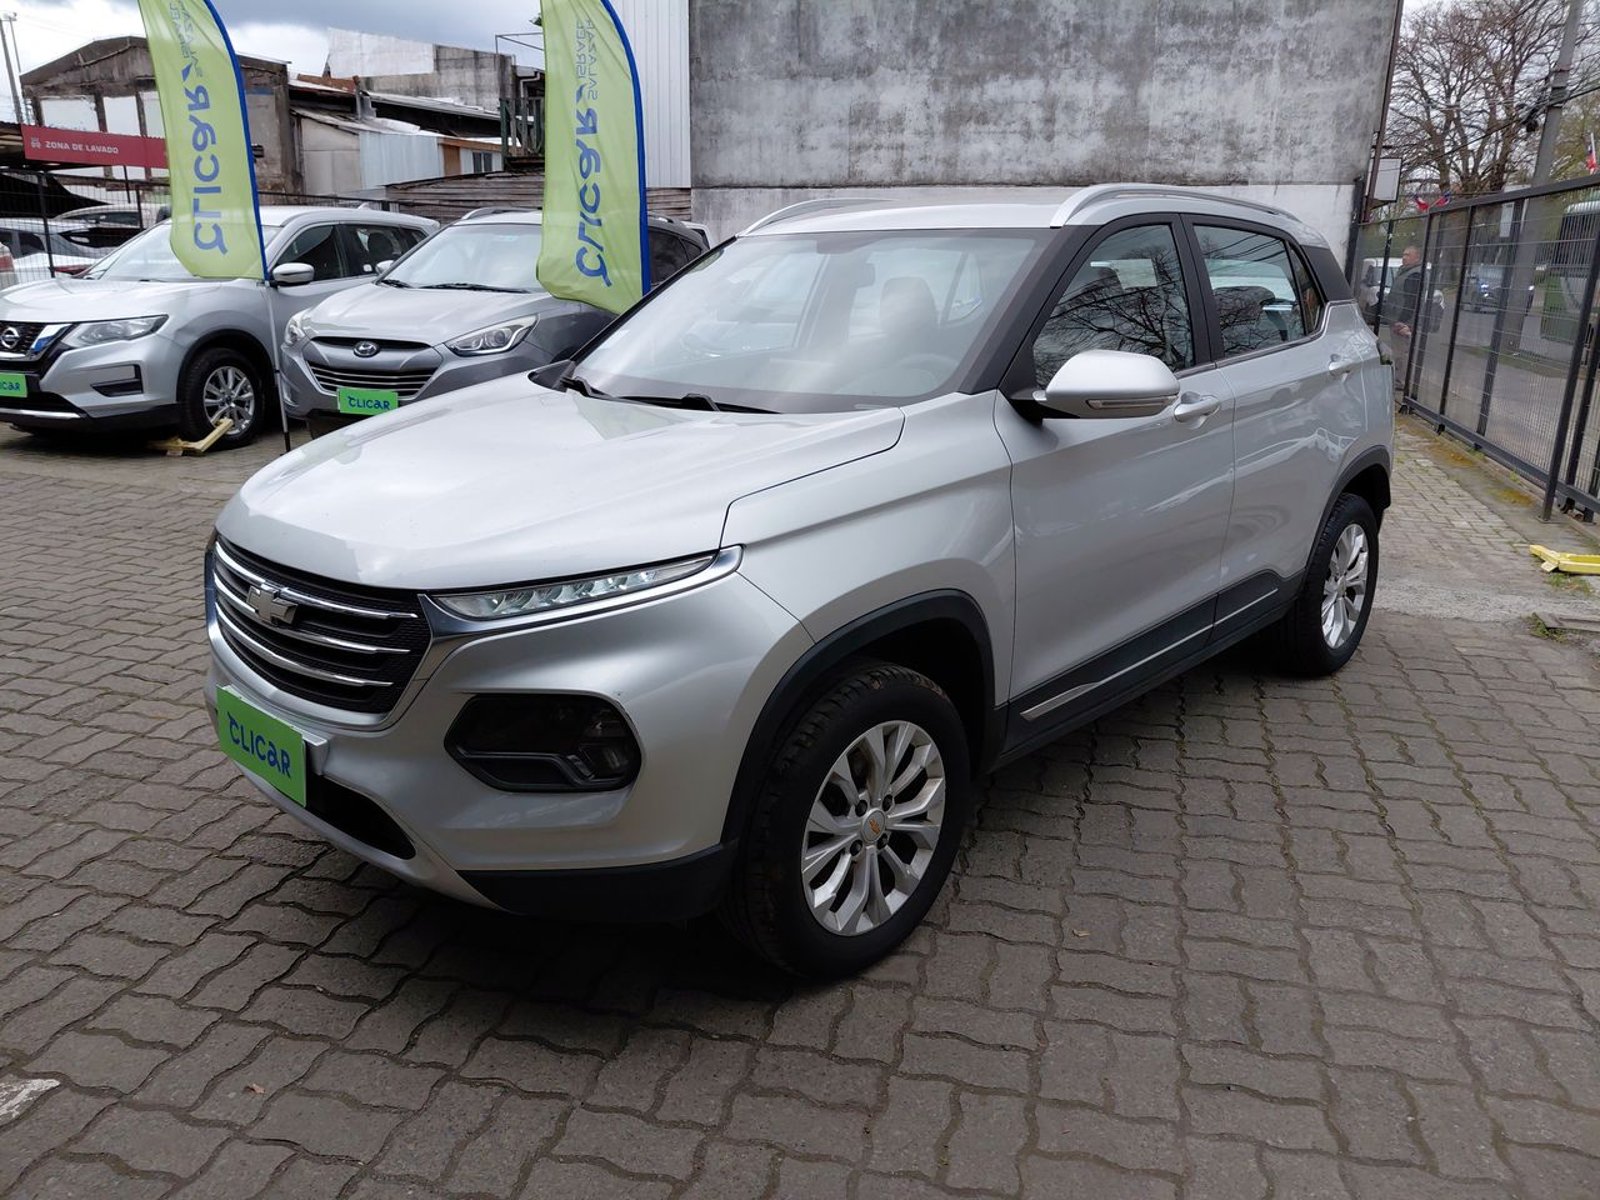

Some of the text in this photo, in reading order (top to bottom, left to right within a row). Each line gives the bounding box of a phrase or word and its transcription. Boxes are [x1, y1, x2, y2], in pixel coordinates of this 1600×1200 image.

[45, 140, 119, 154] ZONA DE LAVADO
